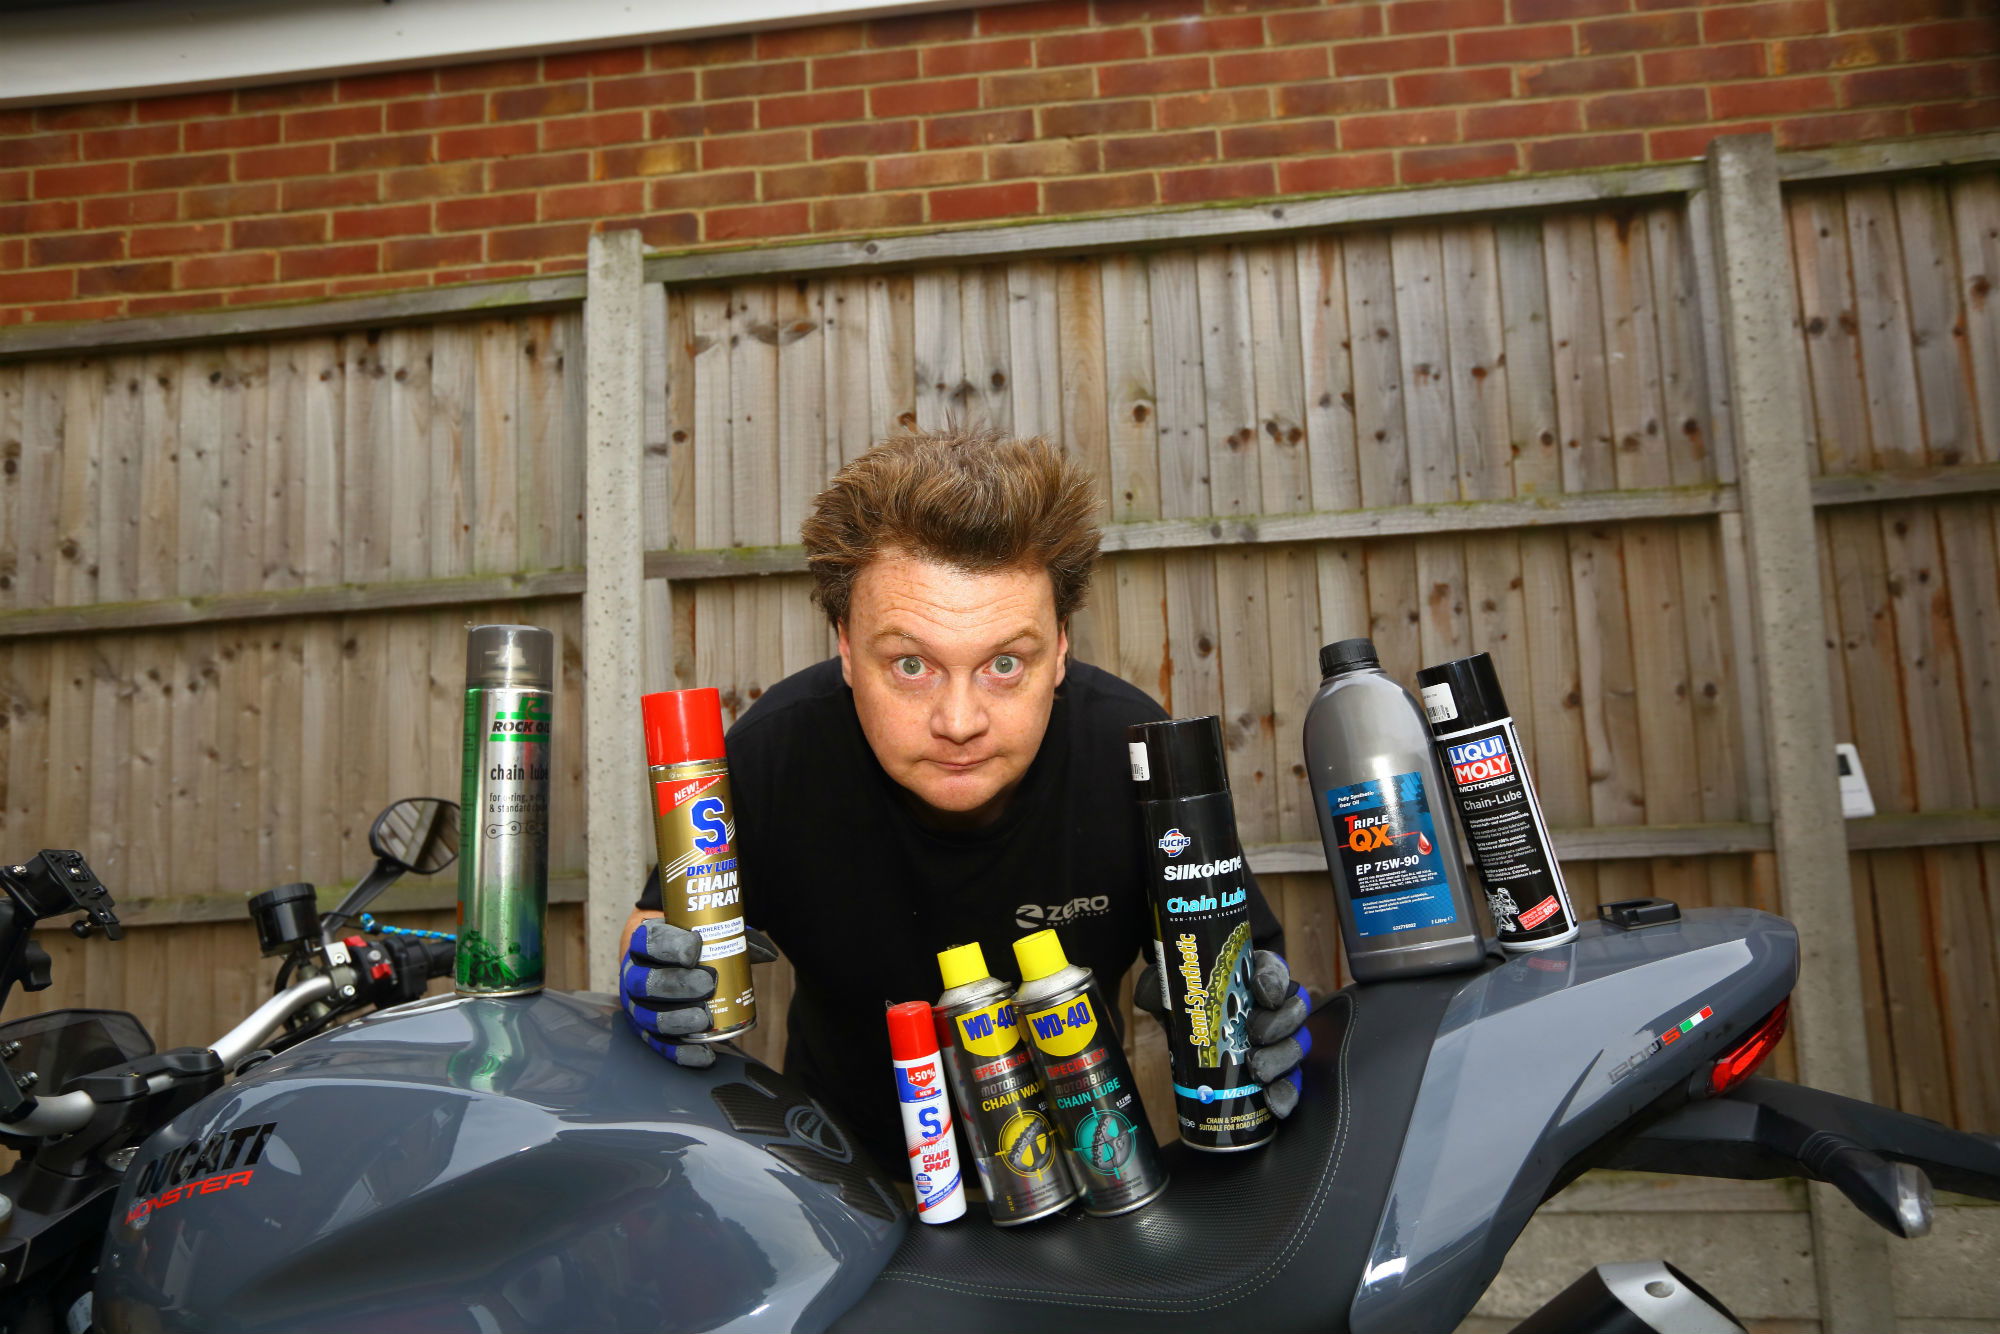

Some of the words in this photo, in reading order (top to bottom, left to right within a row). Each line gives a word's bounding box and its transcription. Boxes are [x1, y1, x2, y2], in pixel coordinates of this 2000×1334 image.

[492, 721, 534, 732] ROCK
[1450, 738, 1503, 764] LIQUI
[490, 764, 525, 780] chain
[1456, 756, 1507, 782] MOLY
[674, 781, 700, 802] NEW!
[1458, 774, 1516, 793] MOTORBIKE
[490, 793, 501, 802] for
[1350, 791, 1375, 800] Synthetic
[1463, 790, 1522, 811] Chain-Lube
[490, 804, 494, 812] &
[497, 804, 531, 812] standard
[690, 796, 729, 856] S
[1344, 814, 1390, 834] TRIPLE
[1160, 838, 1190, 848] FUCHS
[1349, 824, 1394, 852] QX
[686, 863, 713, 877] DRY
[714, 857, 738, 872] LUBE
[1164, 855, 1242, 881] Silkolene
[1356, 864, 1372, 876] EP
[1374, 855, 1420, 872] 75W-90
[686, 870, 738, 894] CHAIN
[687, 887, 740, 912] SPRAY
[1046, 895, 1109, 920] ZERO
[1166, 894, 1218, 914] Chain
[698, 924, 724, 934] ADHERES
[709, 942, 739, 952] Transparent
[1176, 934, 1210, 1047] Semi-Synthetic
[962, 1004, 1018, 1041] WD-40
[1032, 1002, 1091, 1040] WD-40
[1661, 1027, 1681, 1046] S
[1047, 1048, 1106, 1078] SPECIALIST
[909, 1068, 936, 1082] +50%
[982, 1091, 1019, 1112] CHAIN
[1056, 1092, 1092, 1109] CHAIN
[1092, 1077, 1121, 1099] LUBE
[919, 1106, 942, 1140] S
[1230, 1112, 1256, 1123] SPROCKET
[1236, 1122, 1251, 1130] ROAD
[136, 1122, 279, 1198] DUCATI
[922, 1149, 950, 1164] CHAIN
[924, 1158, 951, 1172] SPRAY
[124, 1170, 254, 1225] MONSTER
